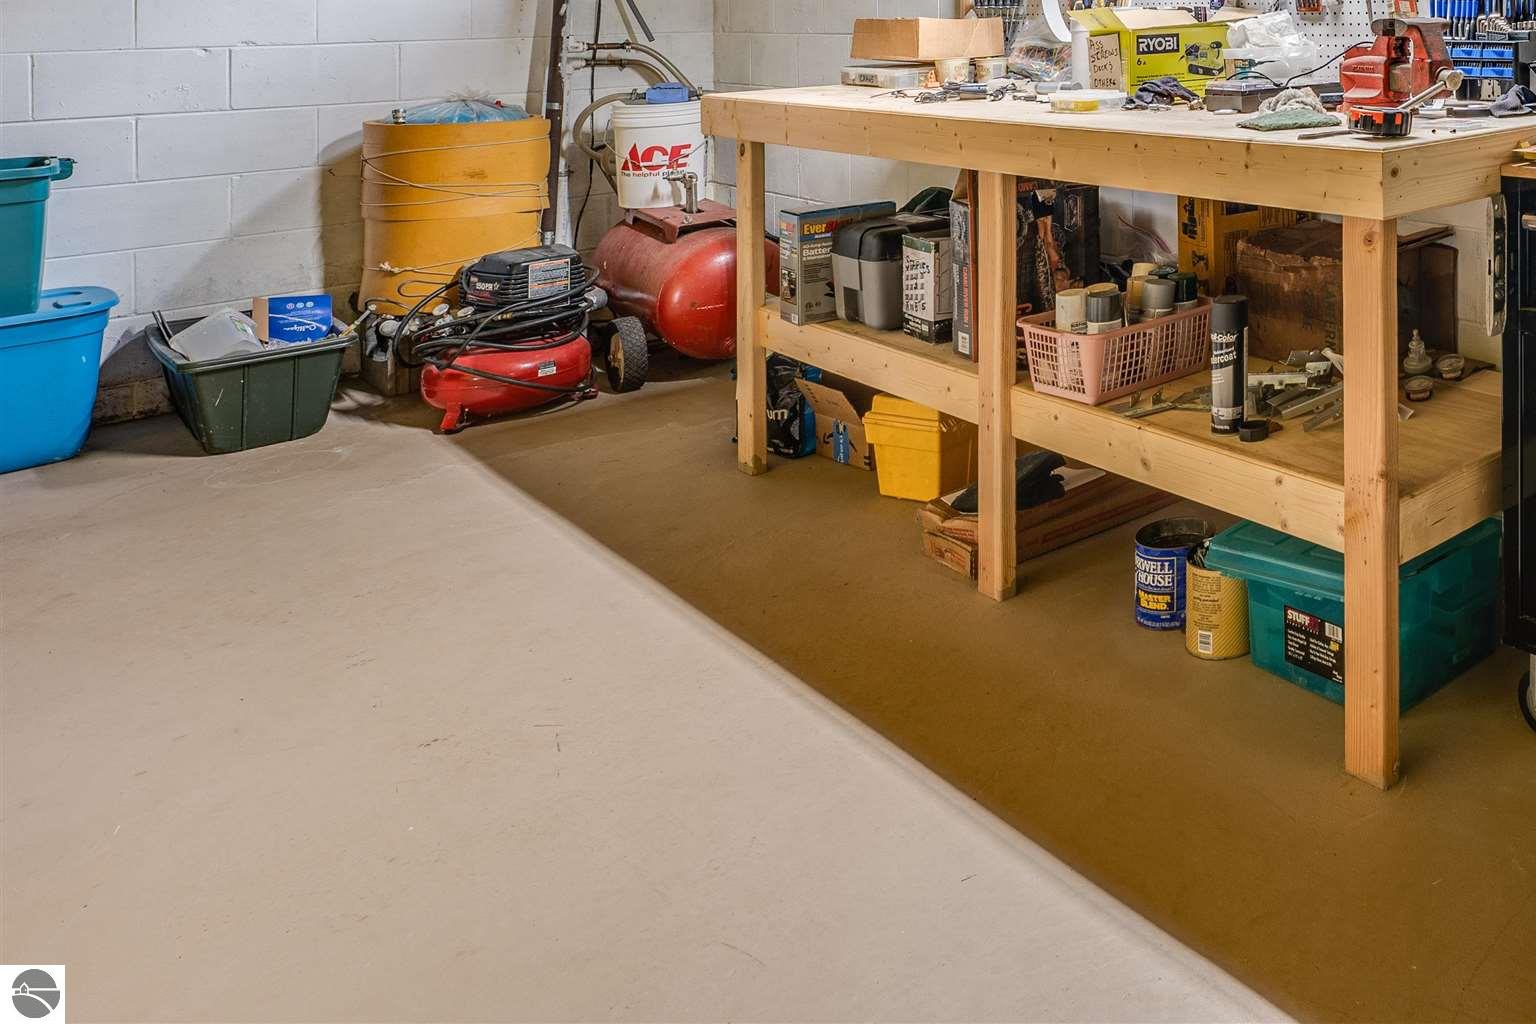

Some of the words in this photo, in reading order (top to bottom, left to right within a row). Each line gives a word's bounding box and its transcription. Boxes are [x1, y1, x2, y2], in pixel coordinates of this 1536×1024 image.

[1138, 36, 1178, 52] RYOBI
[621, 143, 692, 172] ACE
[802, 247, 832, 257] Batter
[1138, 571, 1173, 587] HOUSE
[1138, 590, 1171, 603] MASTER
